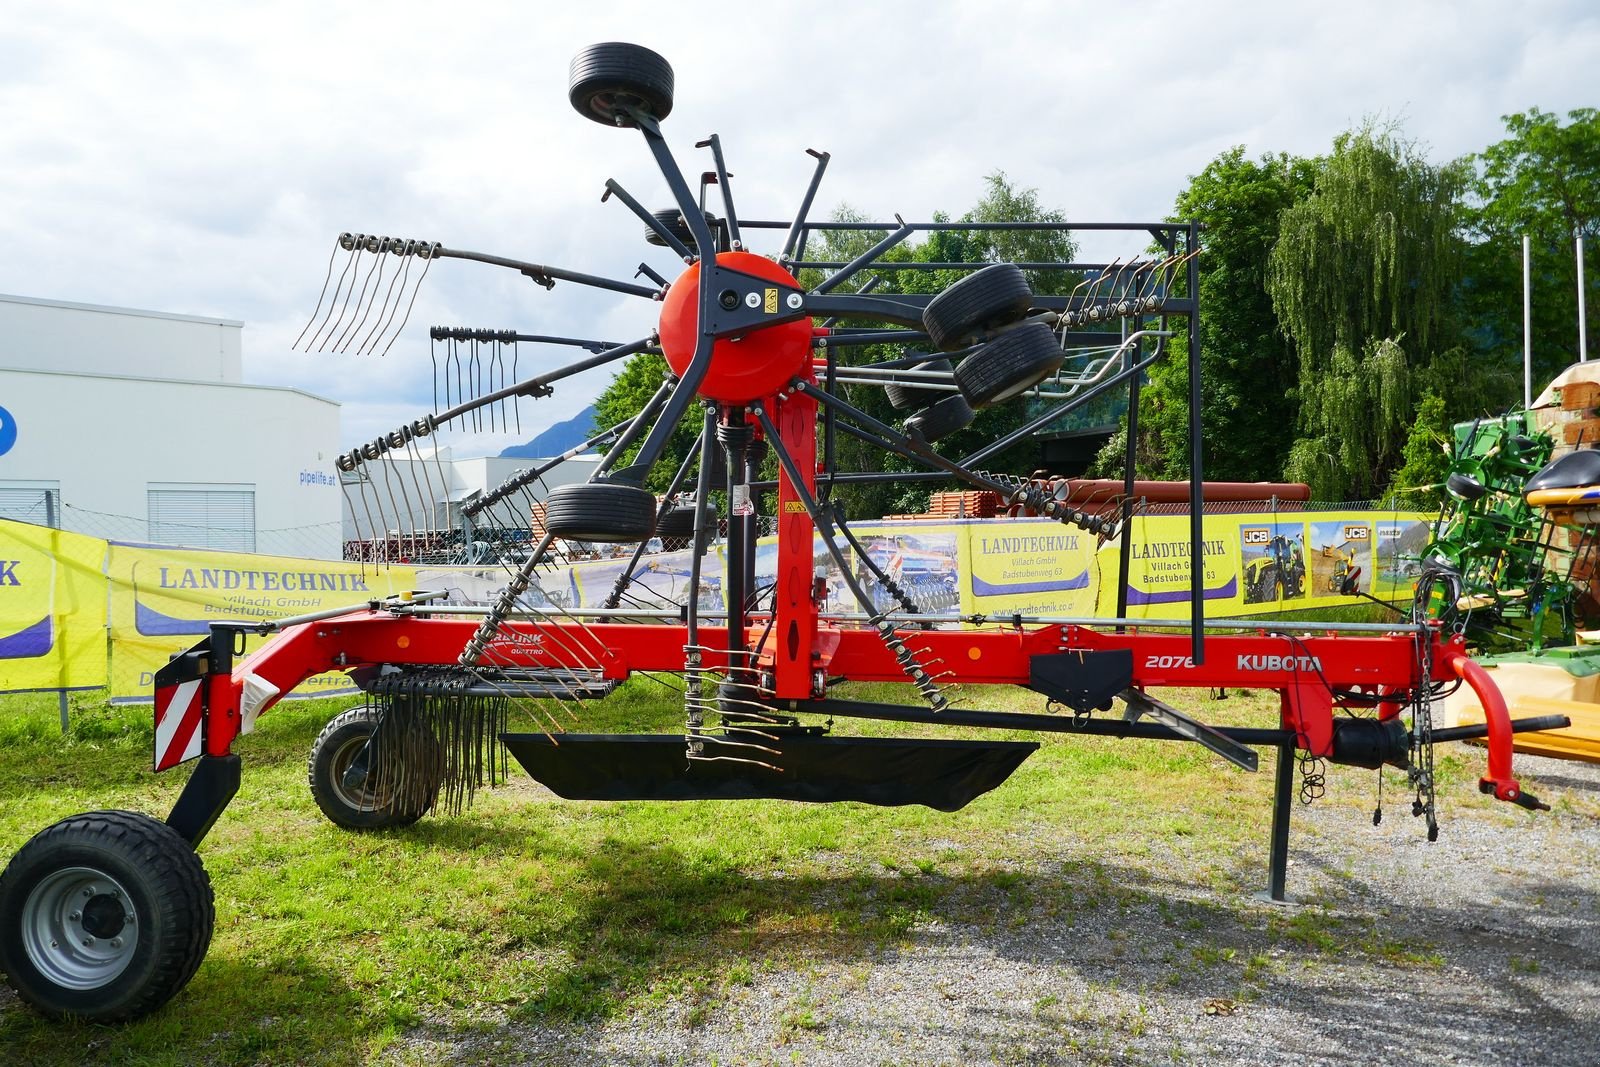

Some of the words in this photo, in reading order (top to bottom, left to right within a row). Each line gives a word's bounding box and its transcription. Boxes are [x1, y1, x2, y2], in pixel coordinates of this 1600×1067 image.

[300, 471, 336, 486] pipelife.at
[1245, 531, 1268, 543] JCB
[1345, 528, 1367, 539] JCB
[981, 535, 1079, 554] LANDTECHNIK
[1132, 540, 1225, 559] LANDTECNIK
[1012, 557, 1034, 566] Villach
[1036, 556, 1057, 565] GmbH
[1151, 561, 1182, 571] Villach
[1002, 569, 1053, 579] Badstubenweg
[1055, 567, 1063, 576] 63
[1206, 570, 1216, 579] 63
[159, 567, 370, 592] LANDTECHNIK
[223, 595, 271, 607] Villach
[276, 597, 321, 607] GmbH
[1237, 654, 1323, 672] KUBOTA
